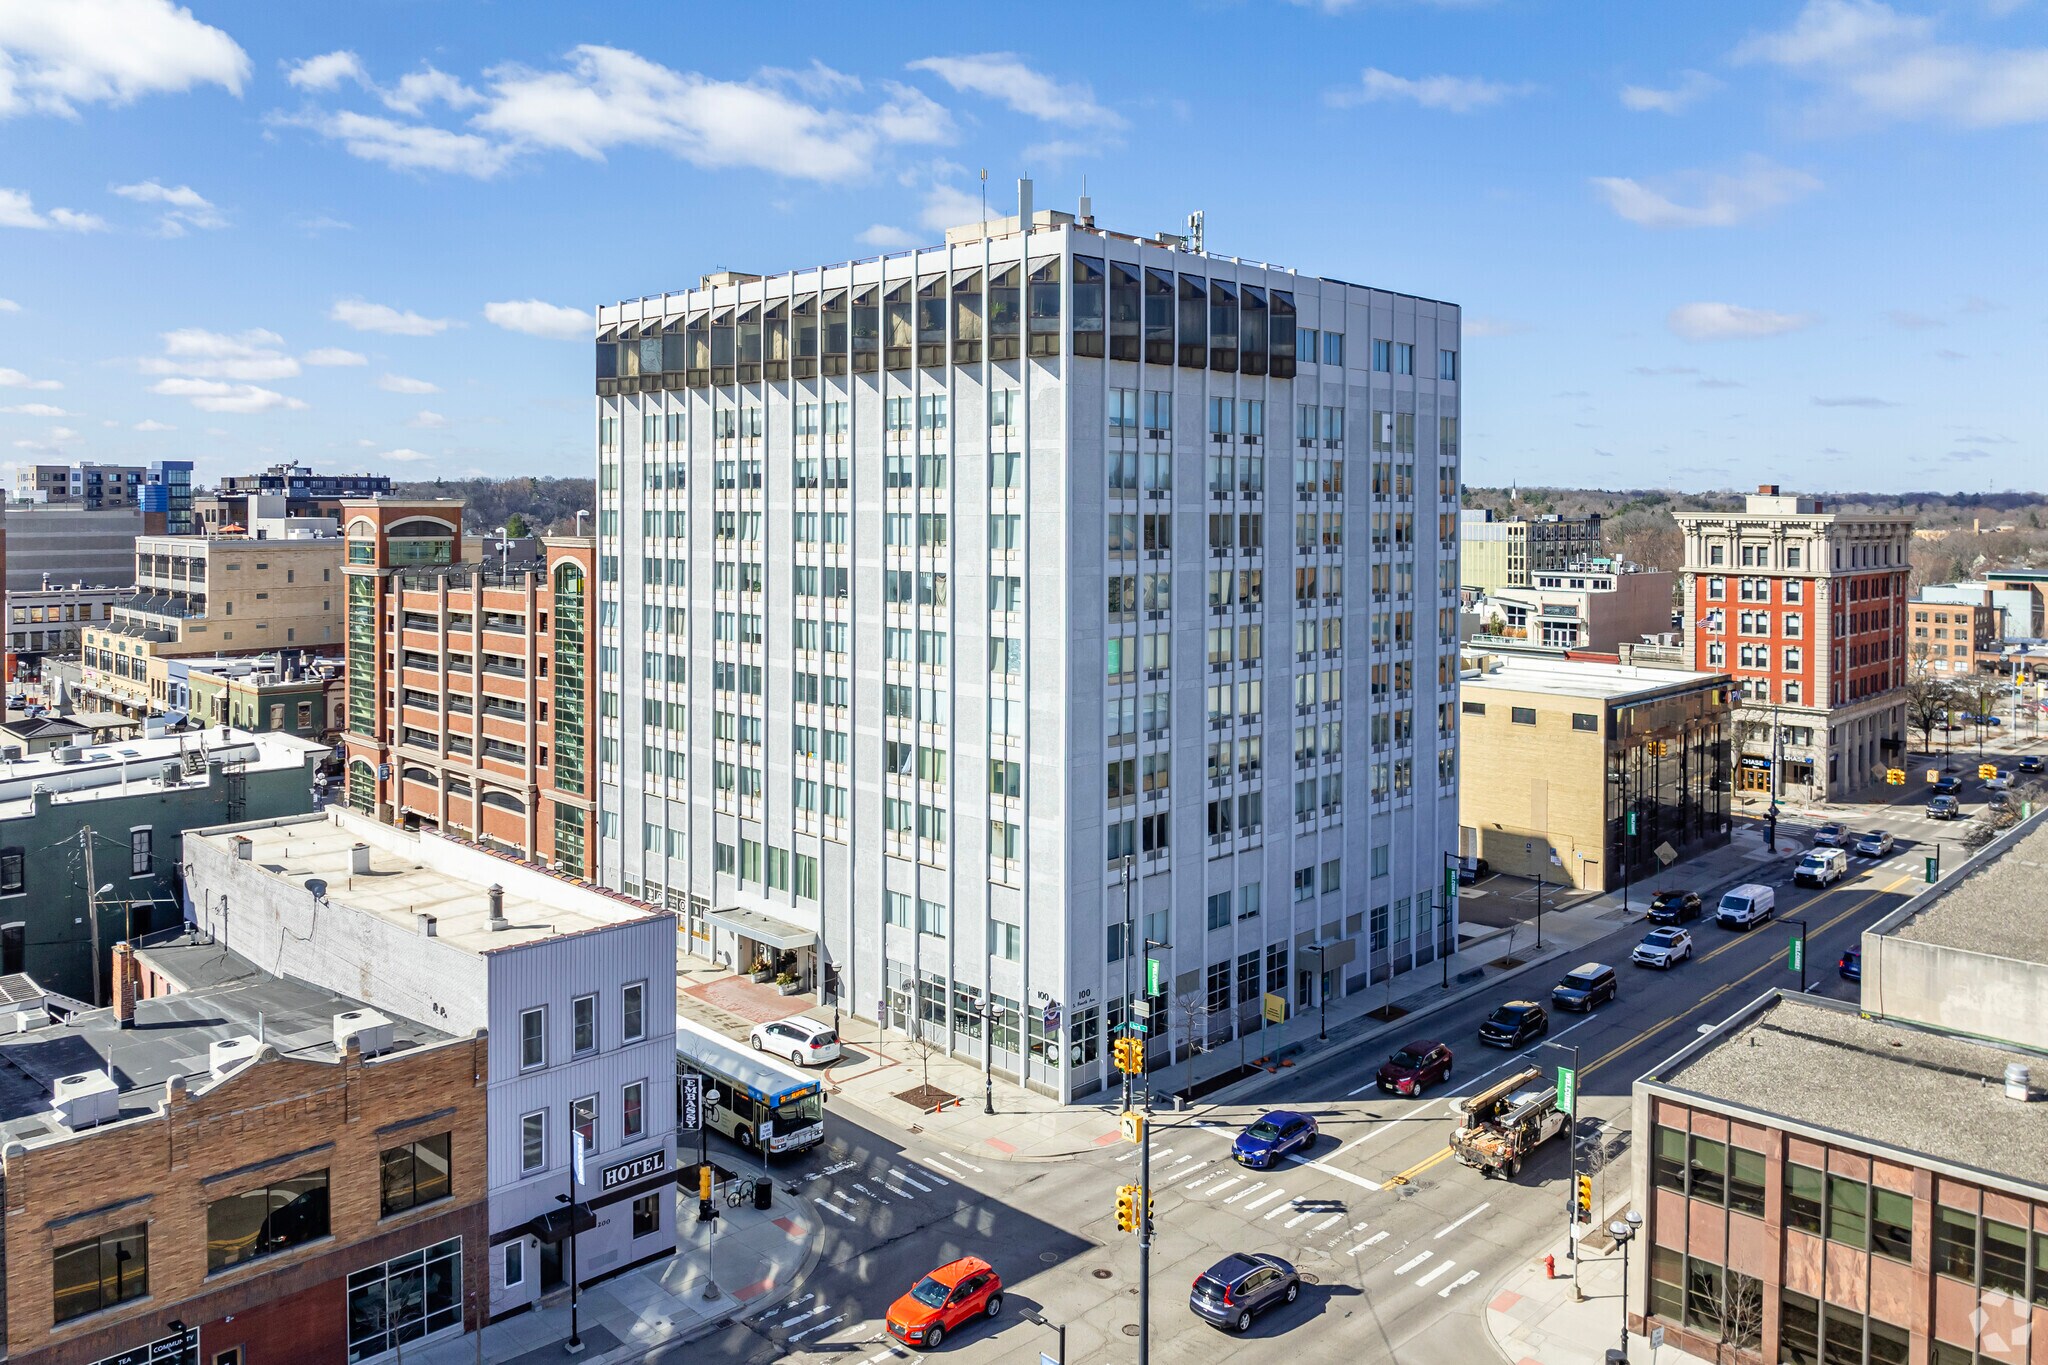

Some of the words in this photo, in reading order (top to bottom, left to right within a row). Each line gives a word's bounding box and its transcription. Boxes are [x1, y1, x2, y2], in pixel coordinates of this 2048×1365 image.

[1742, 758, 1764, 767] CHASE
[1038, 991, 1050, 1001] 100
[1079, 989, 1091, 999] 100
[1564, 1072, 1573, 1107] WELCOME!
[684, 1079, 698, 1128] EMBASSY
[605, 1154, 664, 1187] HOTEL
[598, 1218, 611, 1228] 200
[153, 1334, 195, 1354] COMMUNTY
[118, 1356, 132, 1365] TEA
